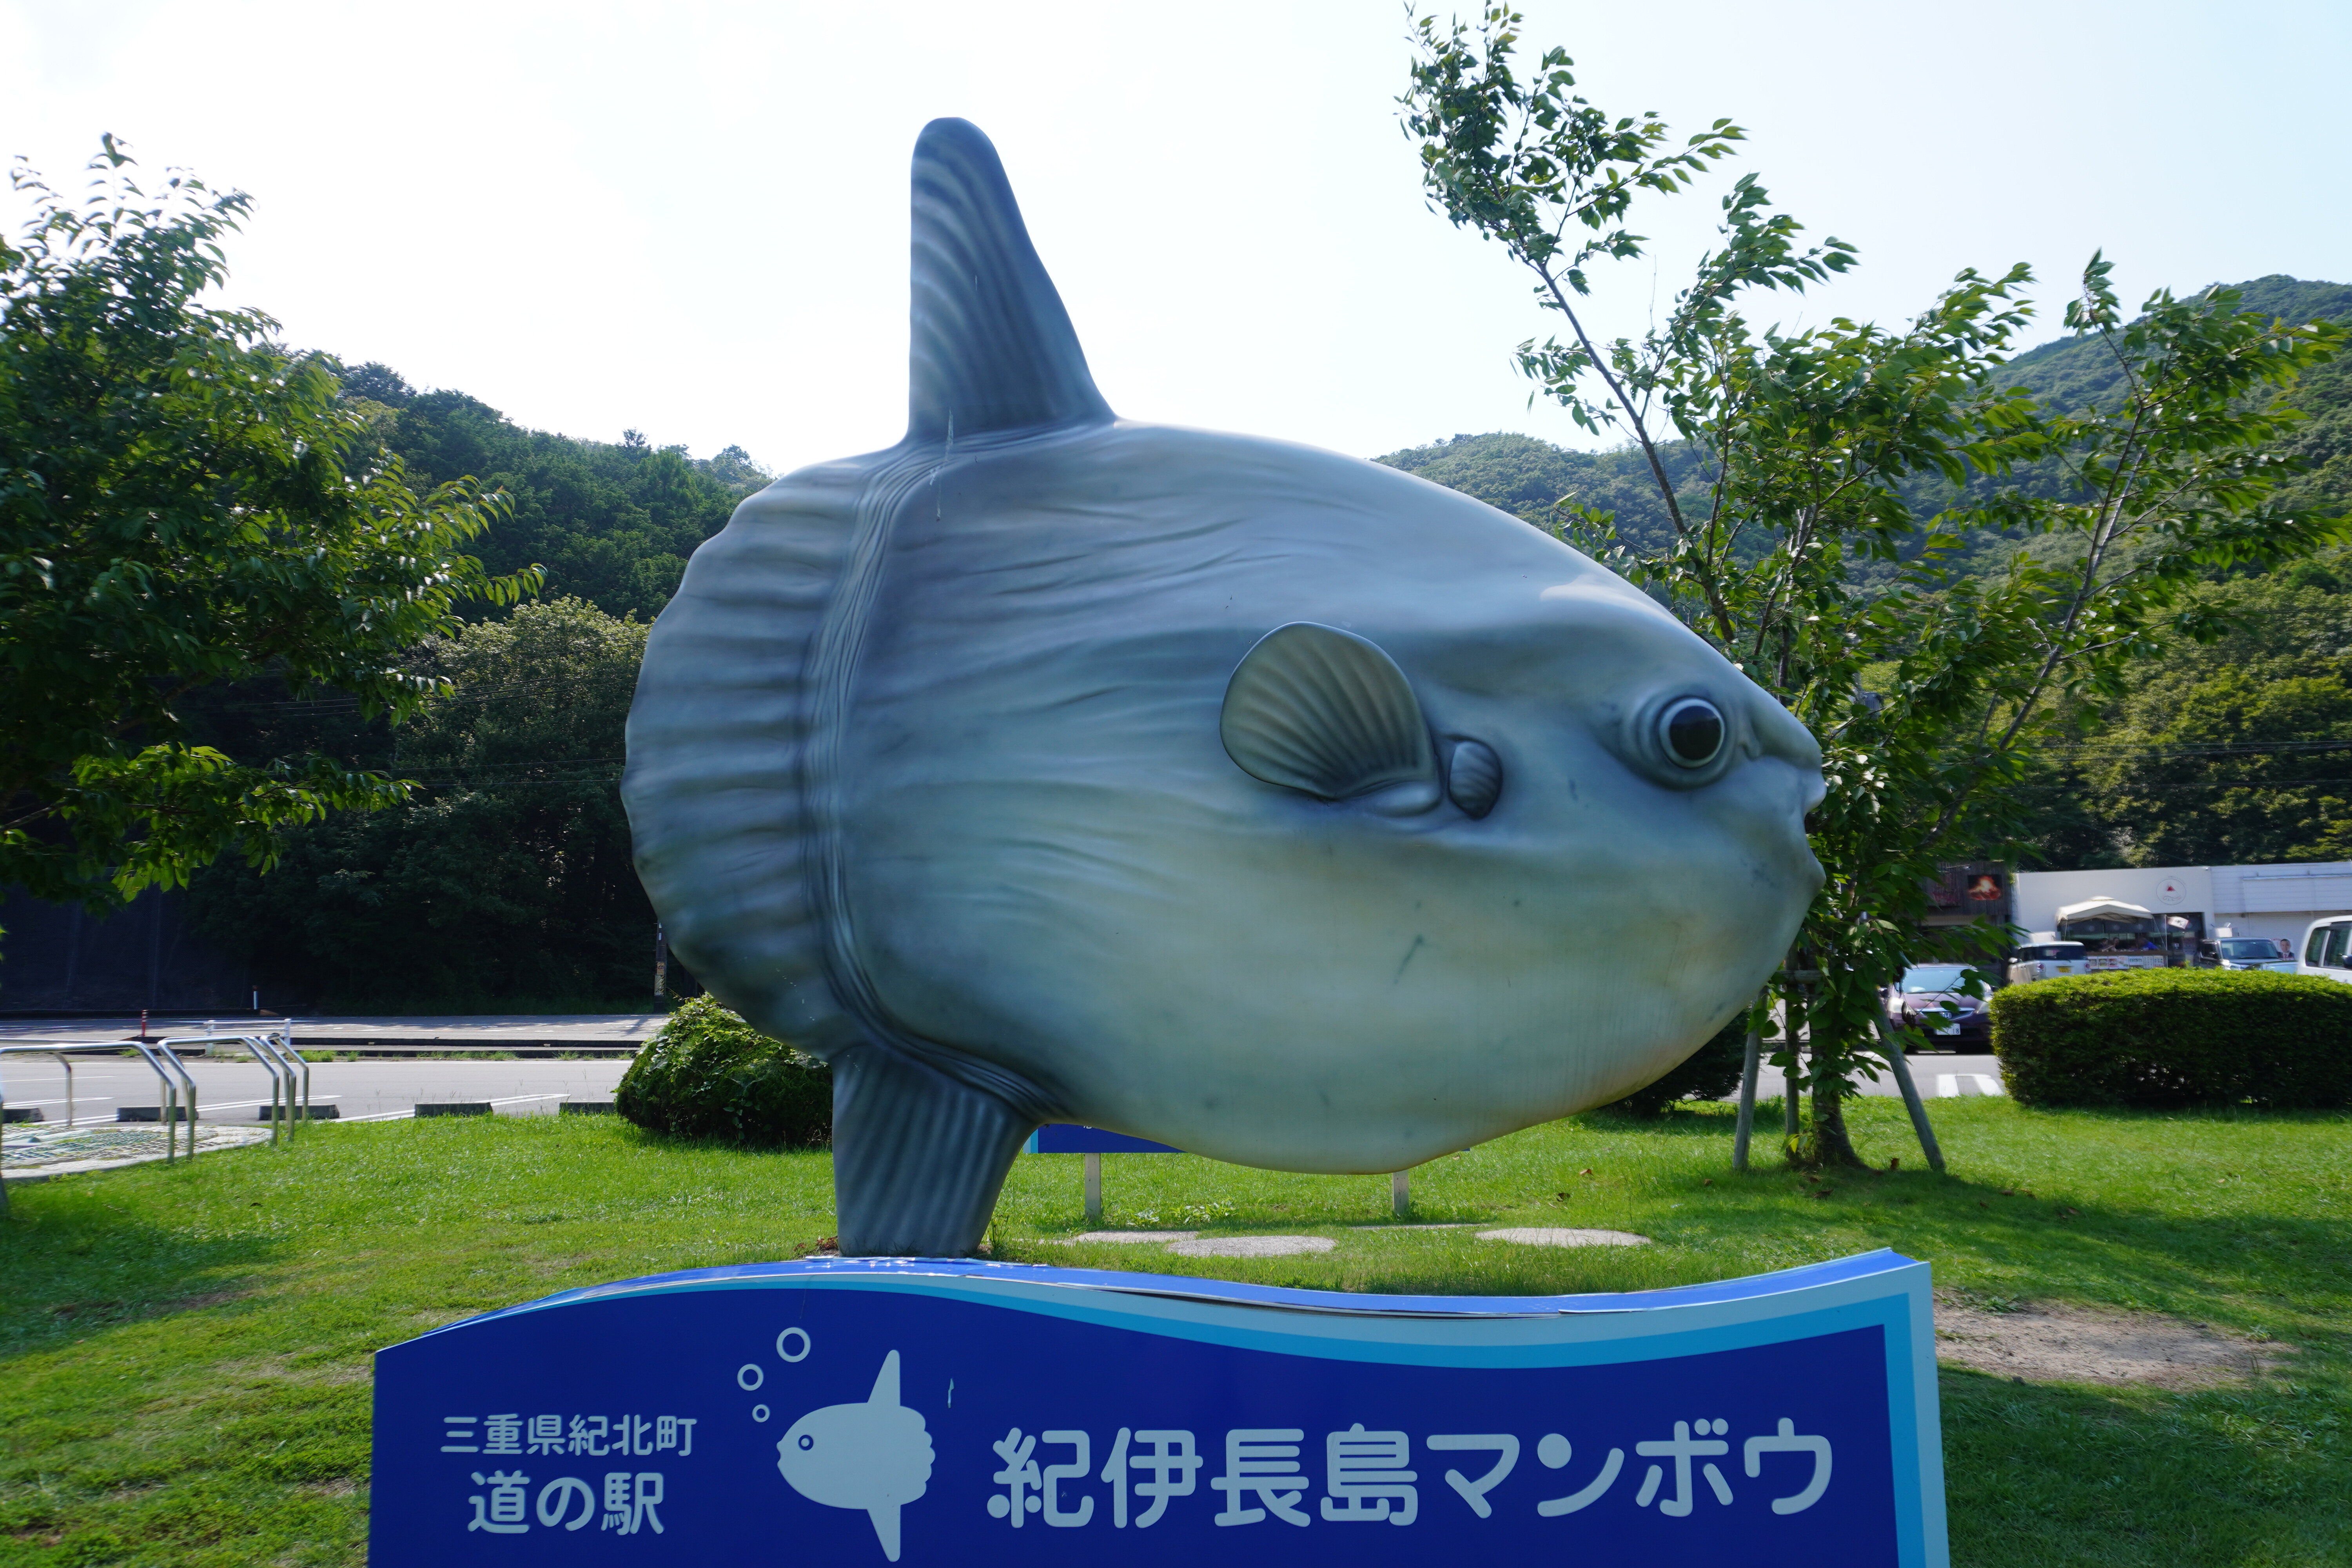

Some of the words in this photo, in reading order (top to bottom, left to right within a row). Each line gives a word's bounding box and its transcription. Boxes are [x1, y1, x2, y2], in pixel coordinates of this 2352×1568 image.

[441, 1414, 697, 1456] 三重県紀北町
[468, 1470, 664, 1535] 道の駅
[987, 1417, 1832, 1528] 紀伊長島マンボウ
